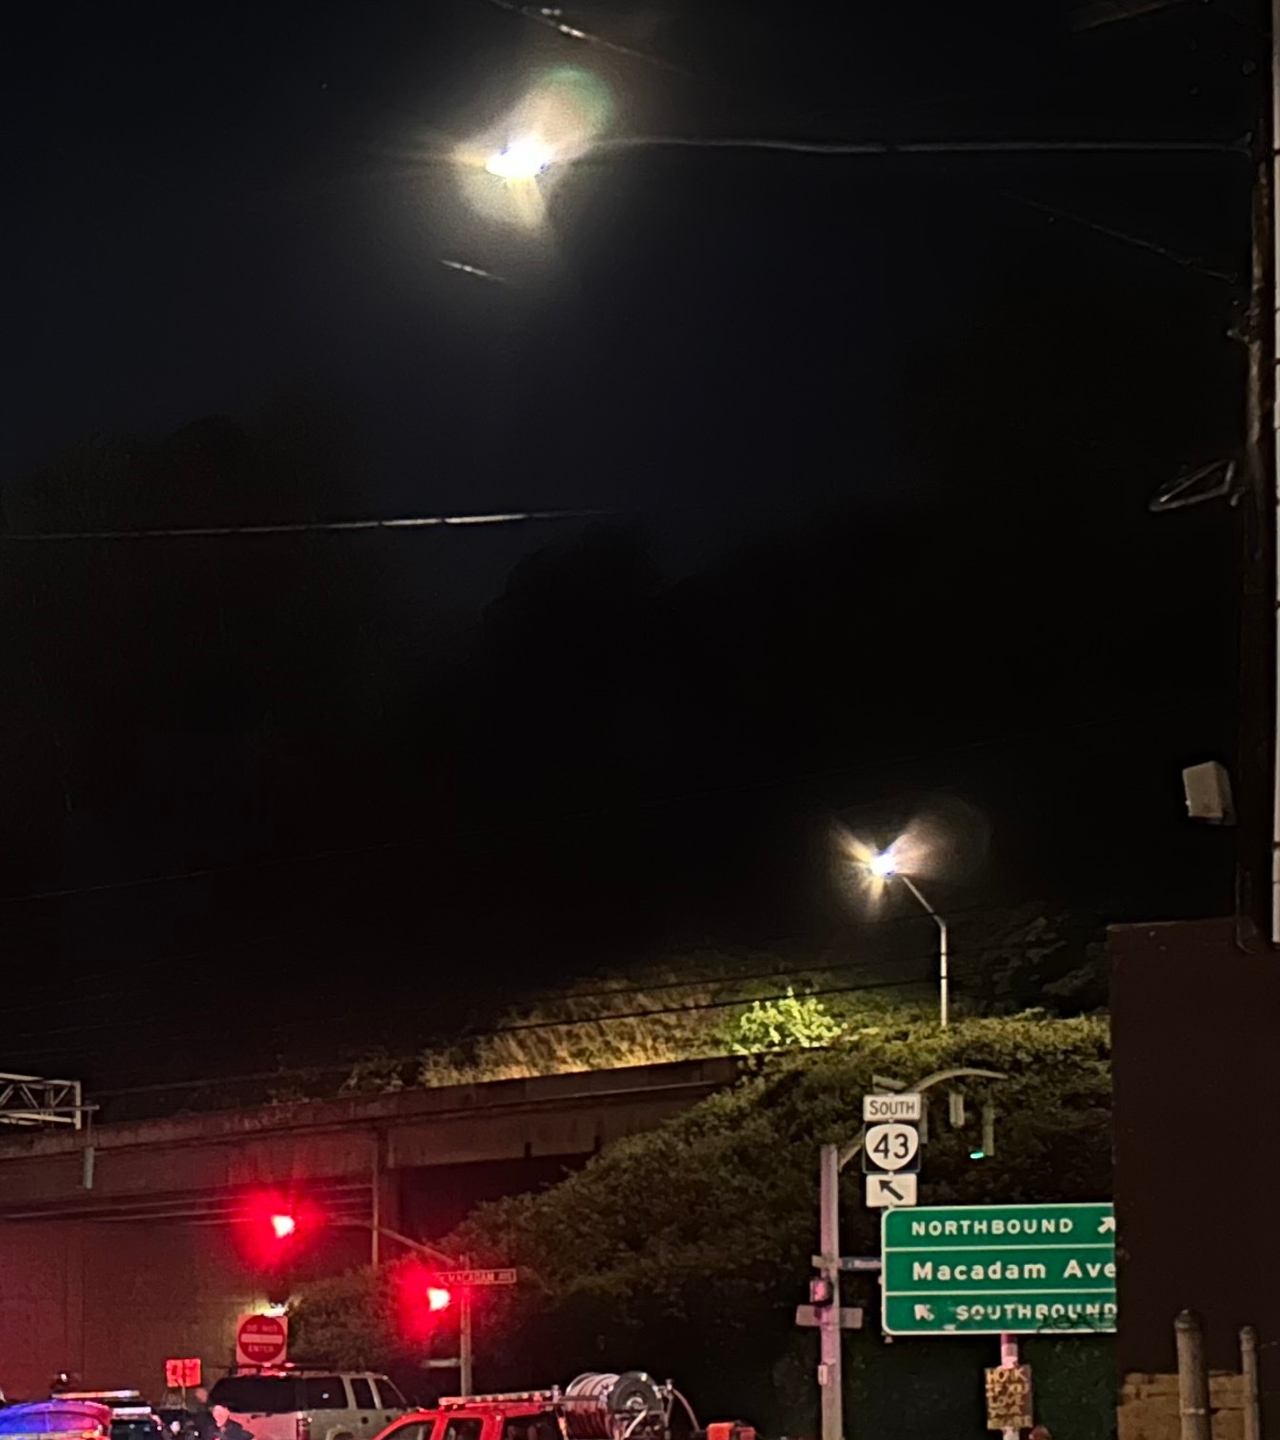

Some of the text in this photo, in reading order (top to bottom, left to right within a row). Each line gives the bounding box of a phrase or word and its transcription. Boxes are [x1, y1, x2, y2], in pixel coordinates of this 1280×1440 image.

[870, 1100, 915, 1116] SOUTH
[873, 1132, 909, 1159] 43
[911, 1218, 1073, 1236] NORTHBOUND
[913, 1259, 1116, 1281] Macadam Ave
[956, 1303, 1117, 1320] SOUTHBOUND
